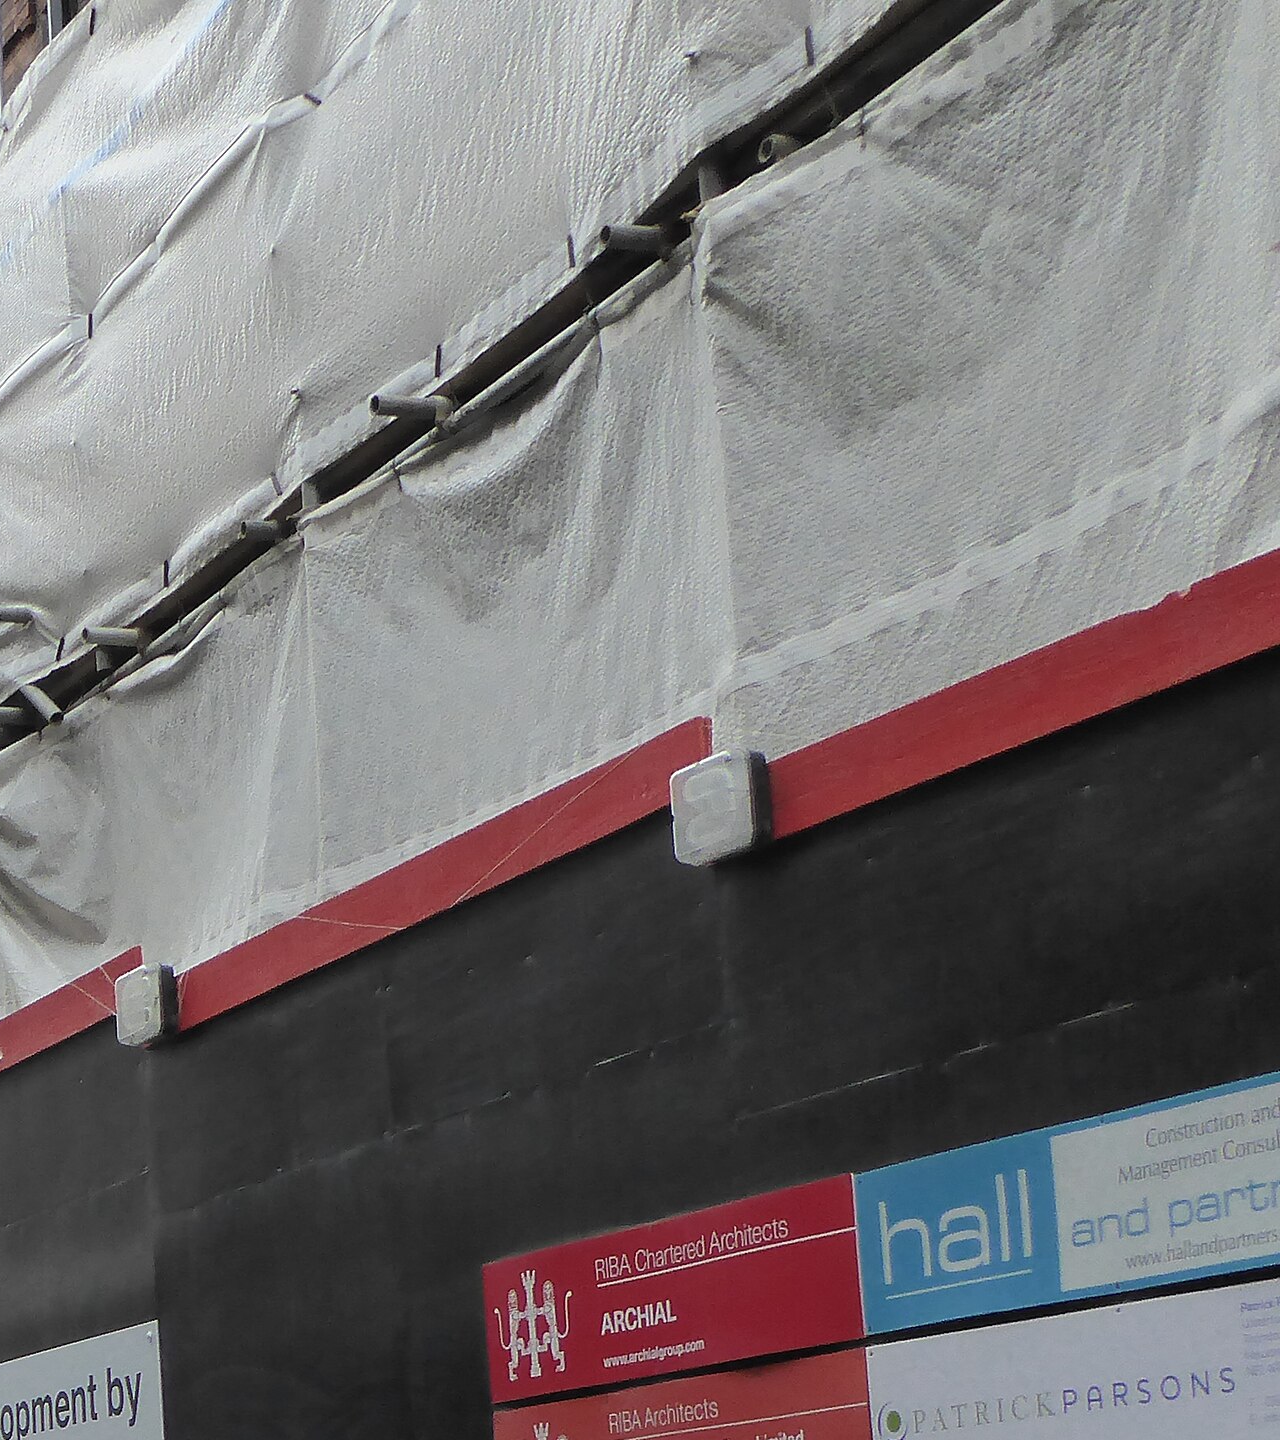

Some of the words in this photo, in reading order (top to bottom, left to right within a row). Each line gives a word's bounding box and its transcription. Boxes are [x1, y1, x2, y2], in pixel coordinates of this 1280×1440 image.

[1146, 1111, 1245, 1148] Construction
[1118, 1148, 1217, 1185] Management
[878, 1168, 1032, 1285] hall
[1072, 1197, 1149, 1248] and
[595, 1258, 631, 1281] RIBA
[635, 1235, 705, 1272] Chartered
[709, 1219, 789, 1254] Architects
[601, 1299, 677, 1336] ARCHIAL
[603, 1338, 705, 1368] www.archialgroup.com
[106, 1366, 142, 1427] by
[609, 1409, 641, 1434] RIBA
[644, 1399, 719, 1429] Architects
